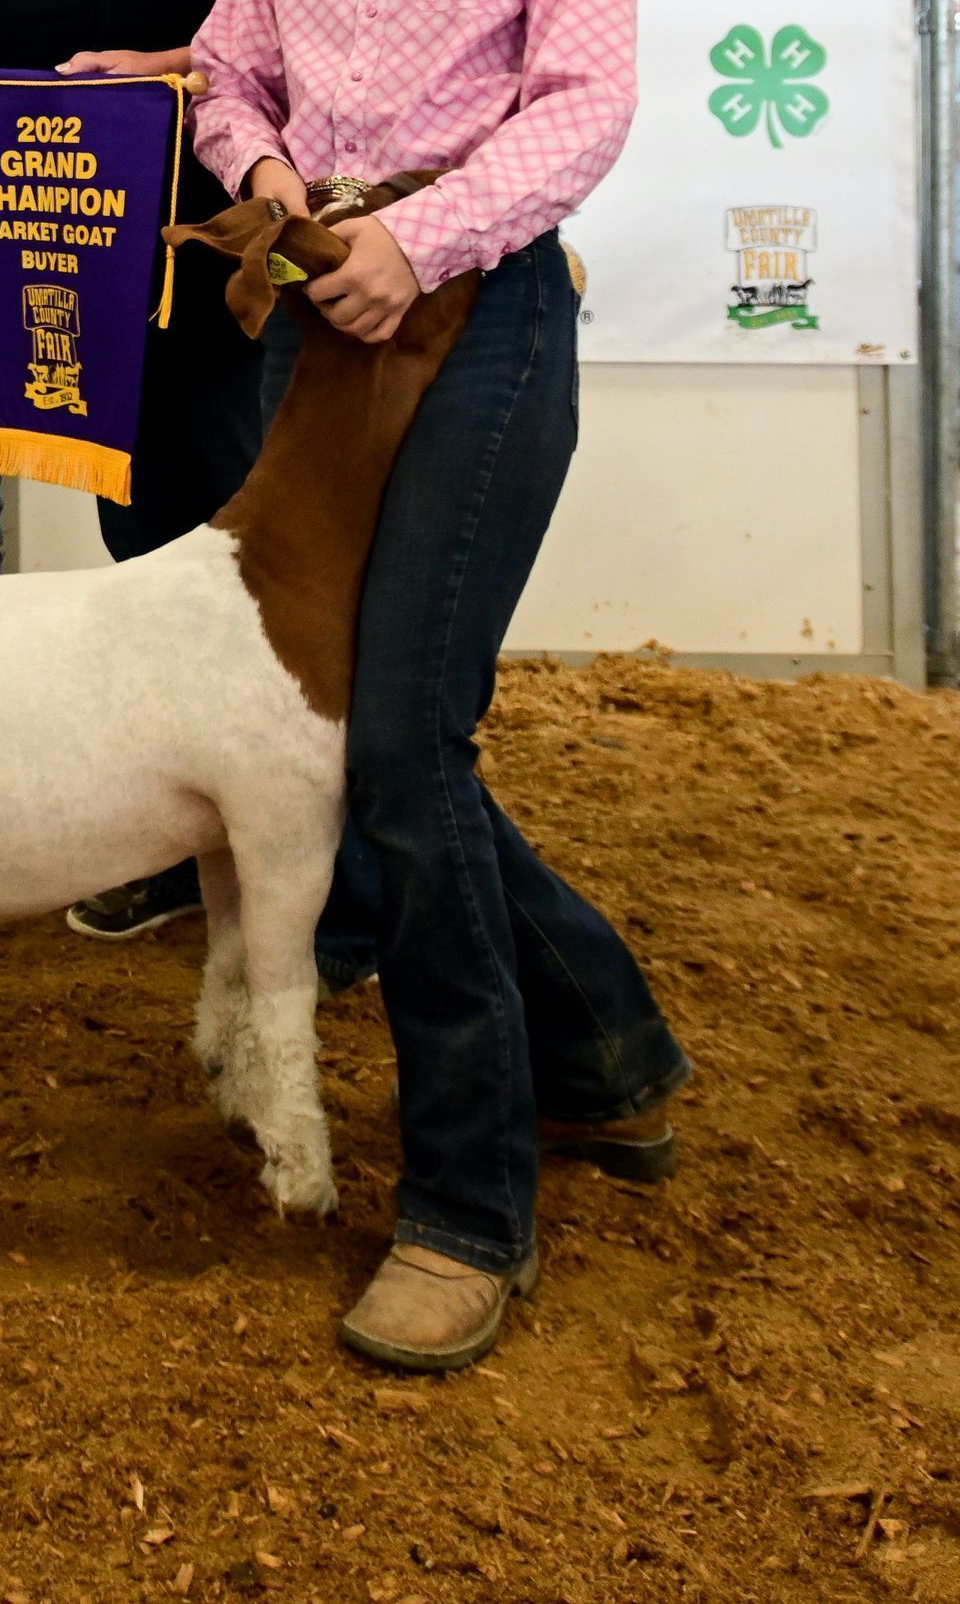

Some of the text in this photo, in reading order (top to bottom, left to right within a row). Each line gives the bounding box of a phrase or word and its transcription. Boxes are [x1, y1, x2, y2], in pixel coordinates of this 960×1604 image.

[16, 116, 82, 144] 2022
[0, 150, 98, 180] GRAND
[62, 225, 117, 247] GOAT
[21, 250, 79, 274] BUYER
[742, 249, 800, 281] FAIR
[27, 288, 75, 311] UMATILLA
[32, 306, 72, 329] COUNTY
[36, 328, 74, 367] FAIR
